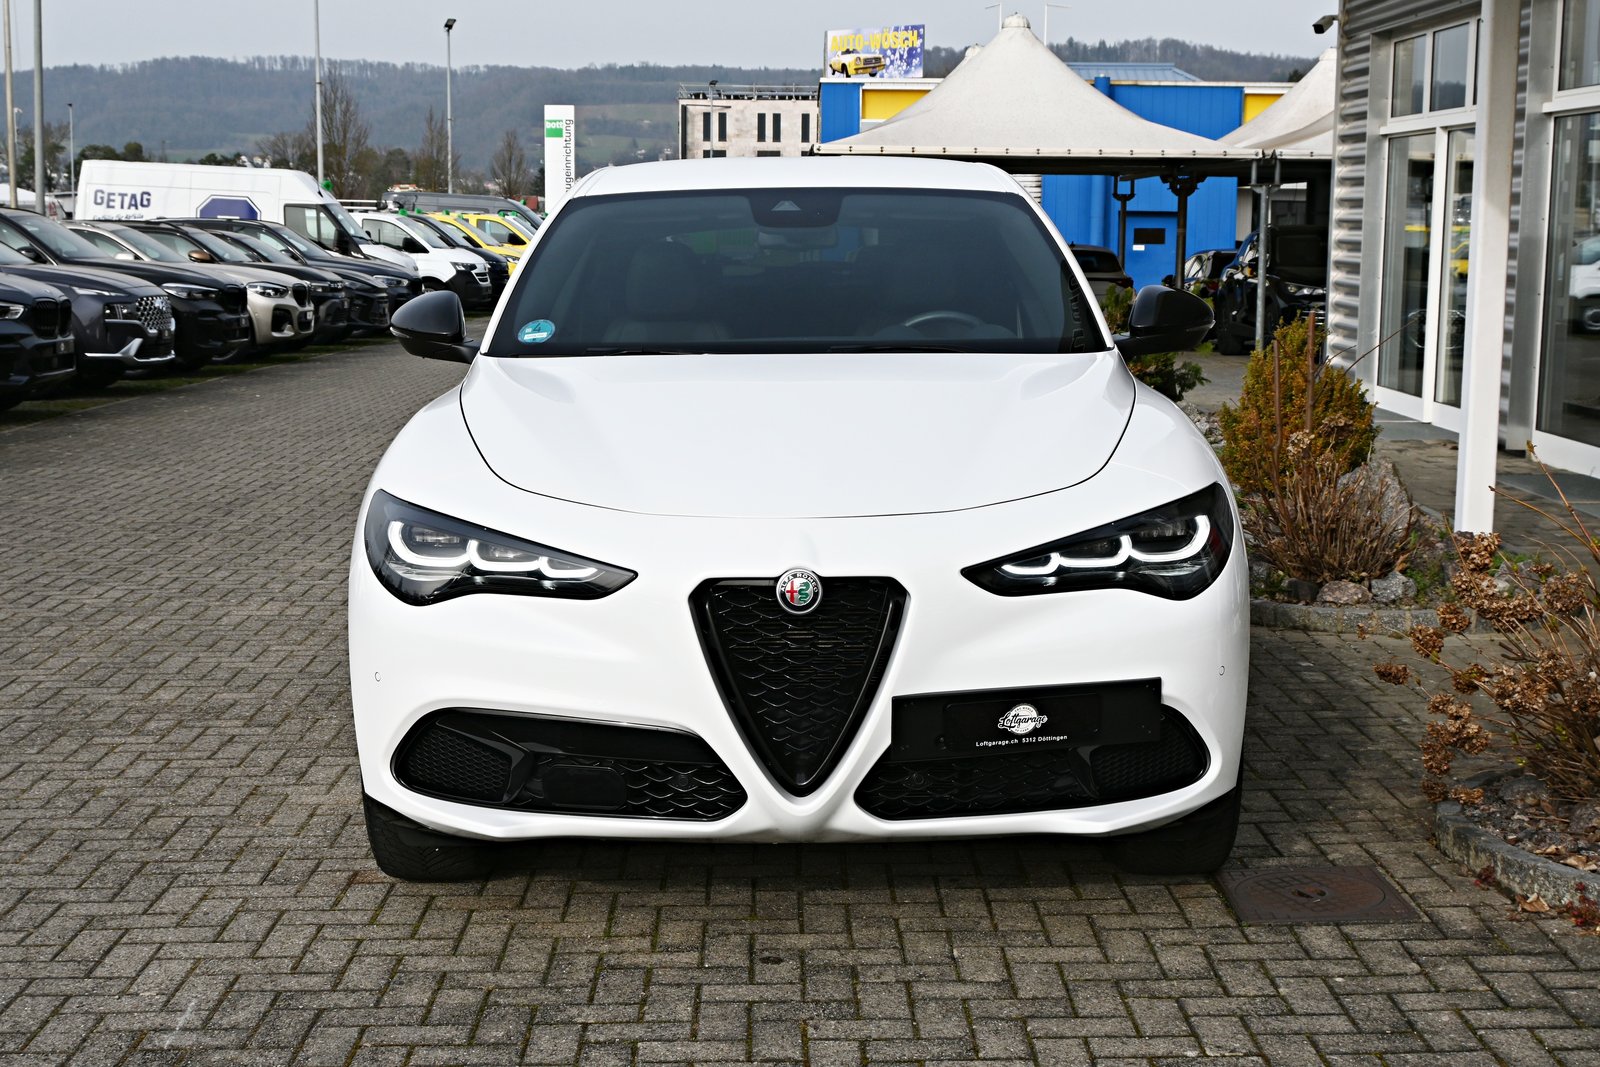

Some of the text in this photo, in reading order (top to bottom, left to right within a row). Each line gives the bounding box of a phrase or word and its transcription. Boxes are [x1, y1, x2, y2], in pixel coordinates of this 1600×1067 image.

[830, 27, 918, 52] AUTO-WÖSCH
[545, 120, 563, 129] bott
[563, 119, 574, 192] ugeinrichtung
[94, 189, 151, 210] GETAG
[533, 322, 542, 333] 4
[781, 573, 818, 593] ALFA ROMEO
[998, 711, 1048, 731] Loftgarage
[975, 738, 1018, 748] Loftgarage.ch
[1037, 735, 1068, 743] Döttingen
